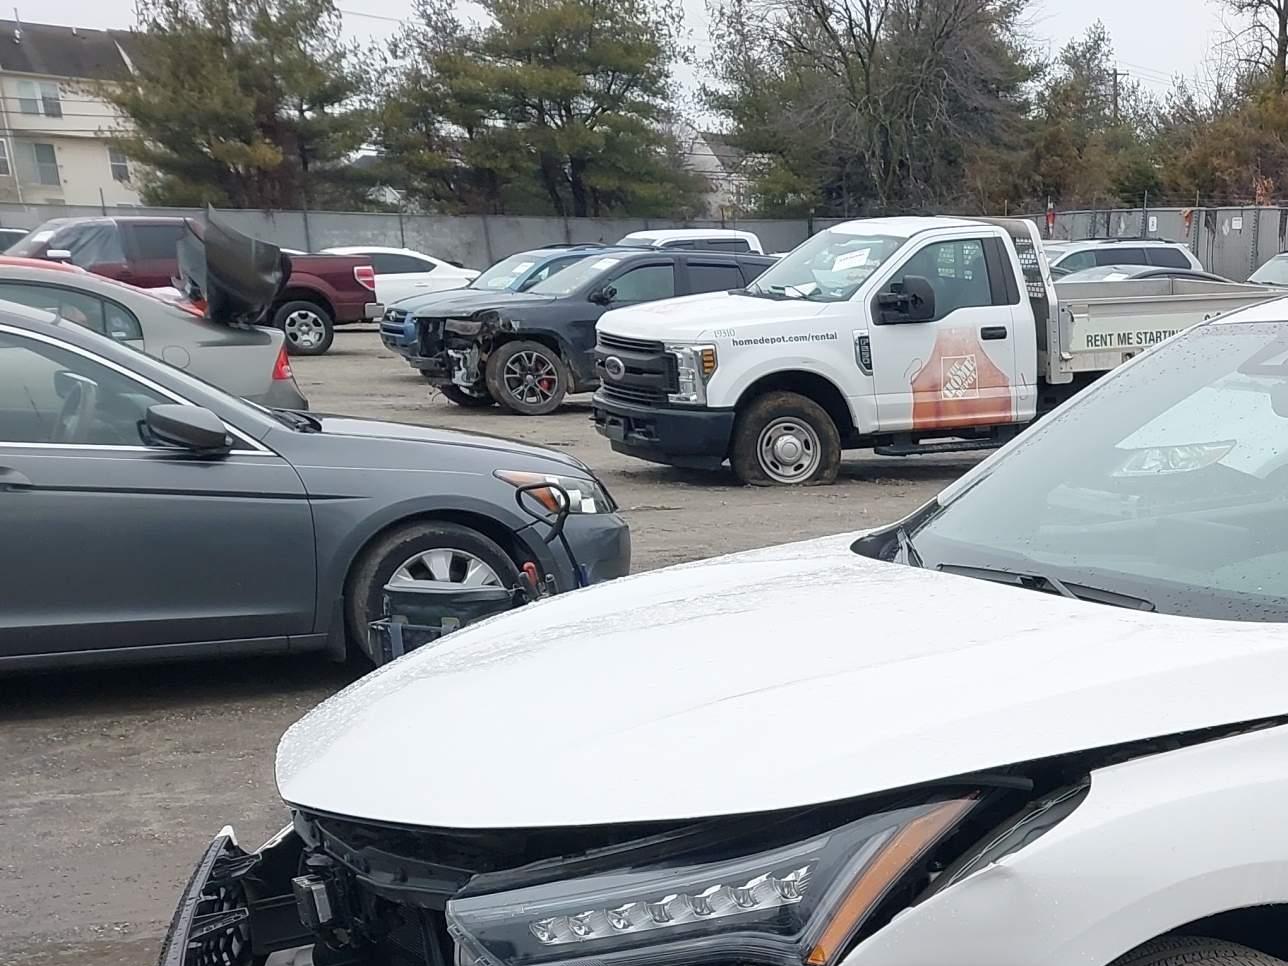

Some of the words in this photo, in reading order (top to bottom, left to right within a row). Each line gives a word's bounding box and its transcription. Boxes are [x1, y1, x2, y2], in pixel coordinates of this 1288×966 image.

[732, 332, 838, 346] homedepot.com/rental
[1086, 333, 1114, 348] RENT
[1117, 332, 1133, 345] ME
[1136, 329, 1184, 344] STARTI
[943, 356, 975, 398] HOME
